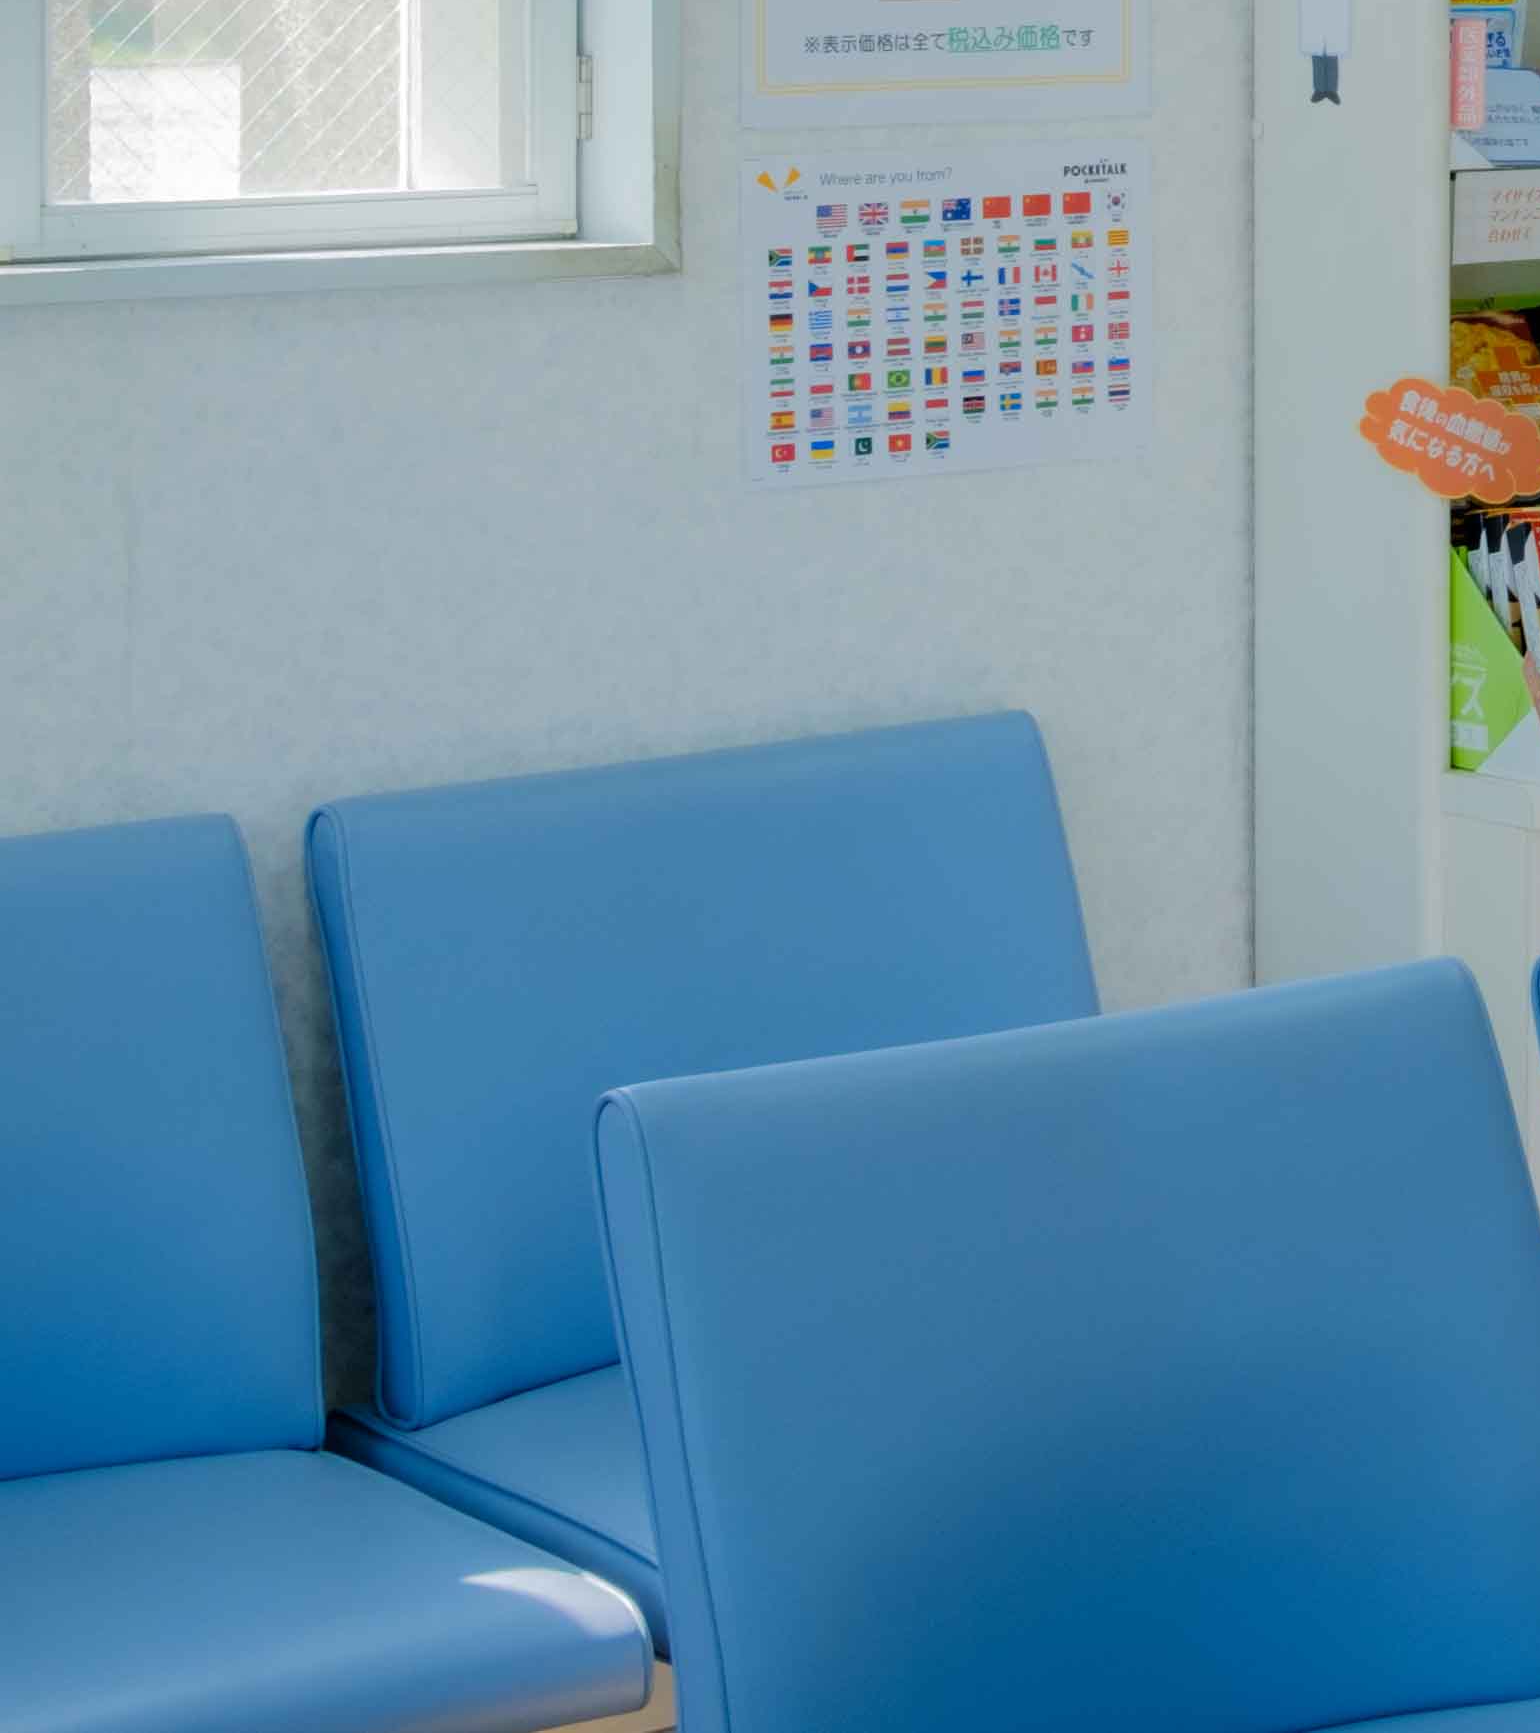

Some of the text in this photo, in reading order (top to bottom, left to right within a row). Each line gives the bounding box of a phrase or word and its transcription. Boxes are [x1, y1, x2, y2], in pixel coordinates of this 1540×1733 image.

[819, 167, 954, 188] Where are you from?
[1063, 162, 1128, 178] POCKETALK
[1387, 418, 1496, 483] 気になる方へ
